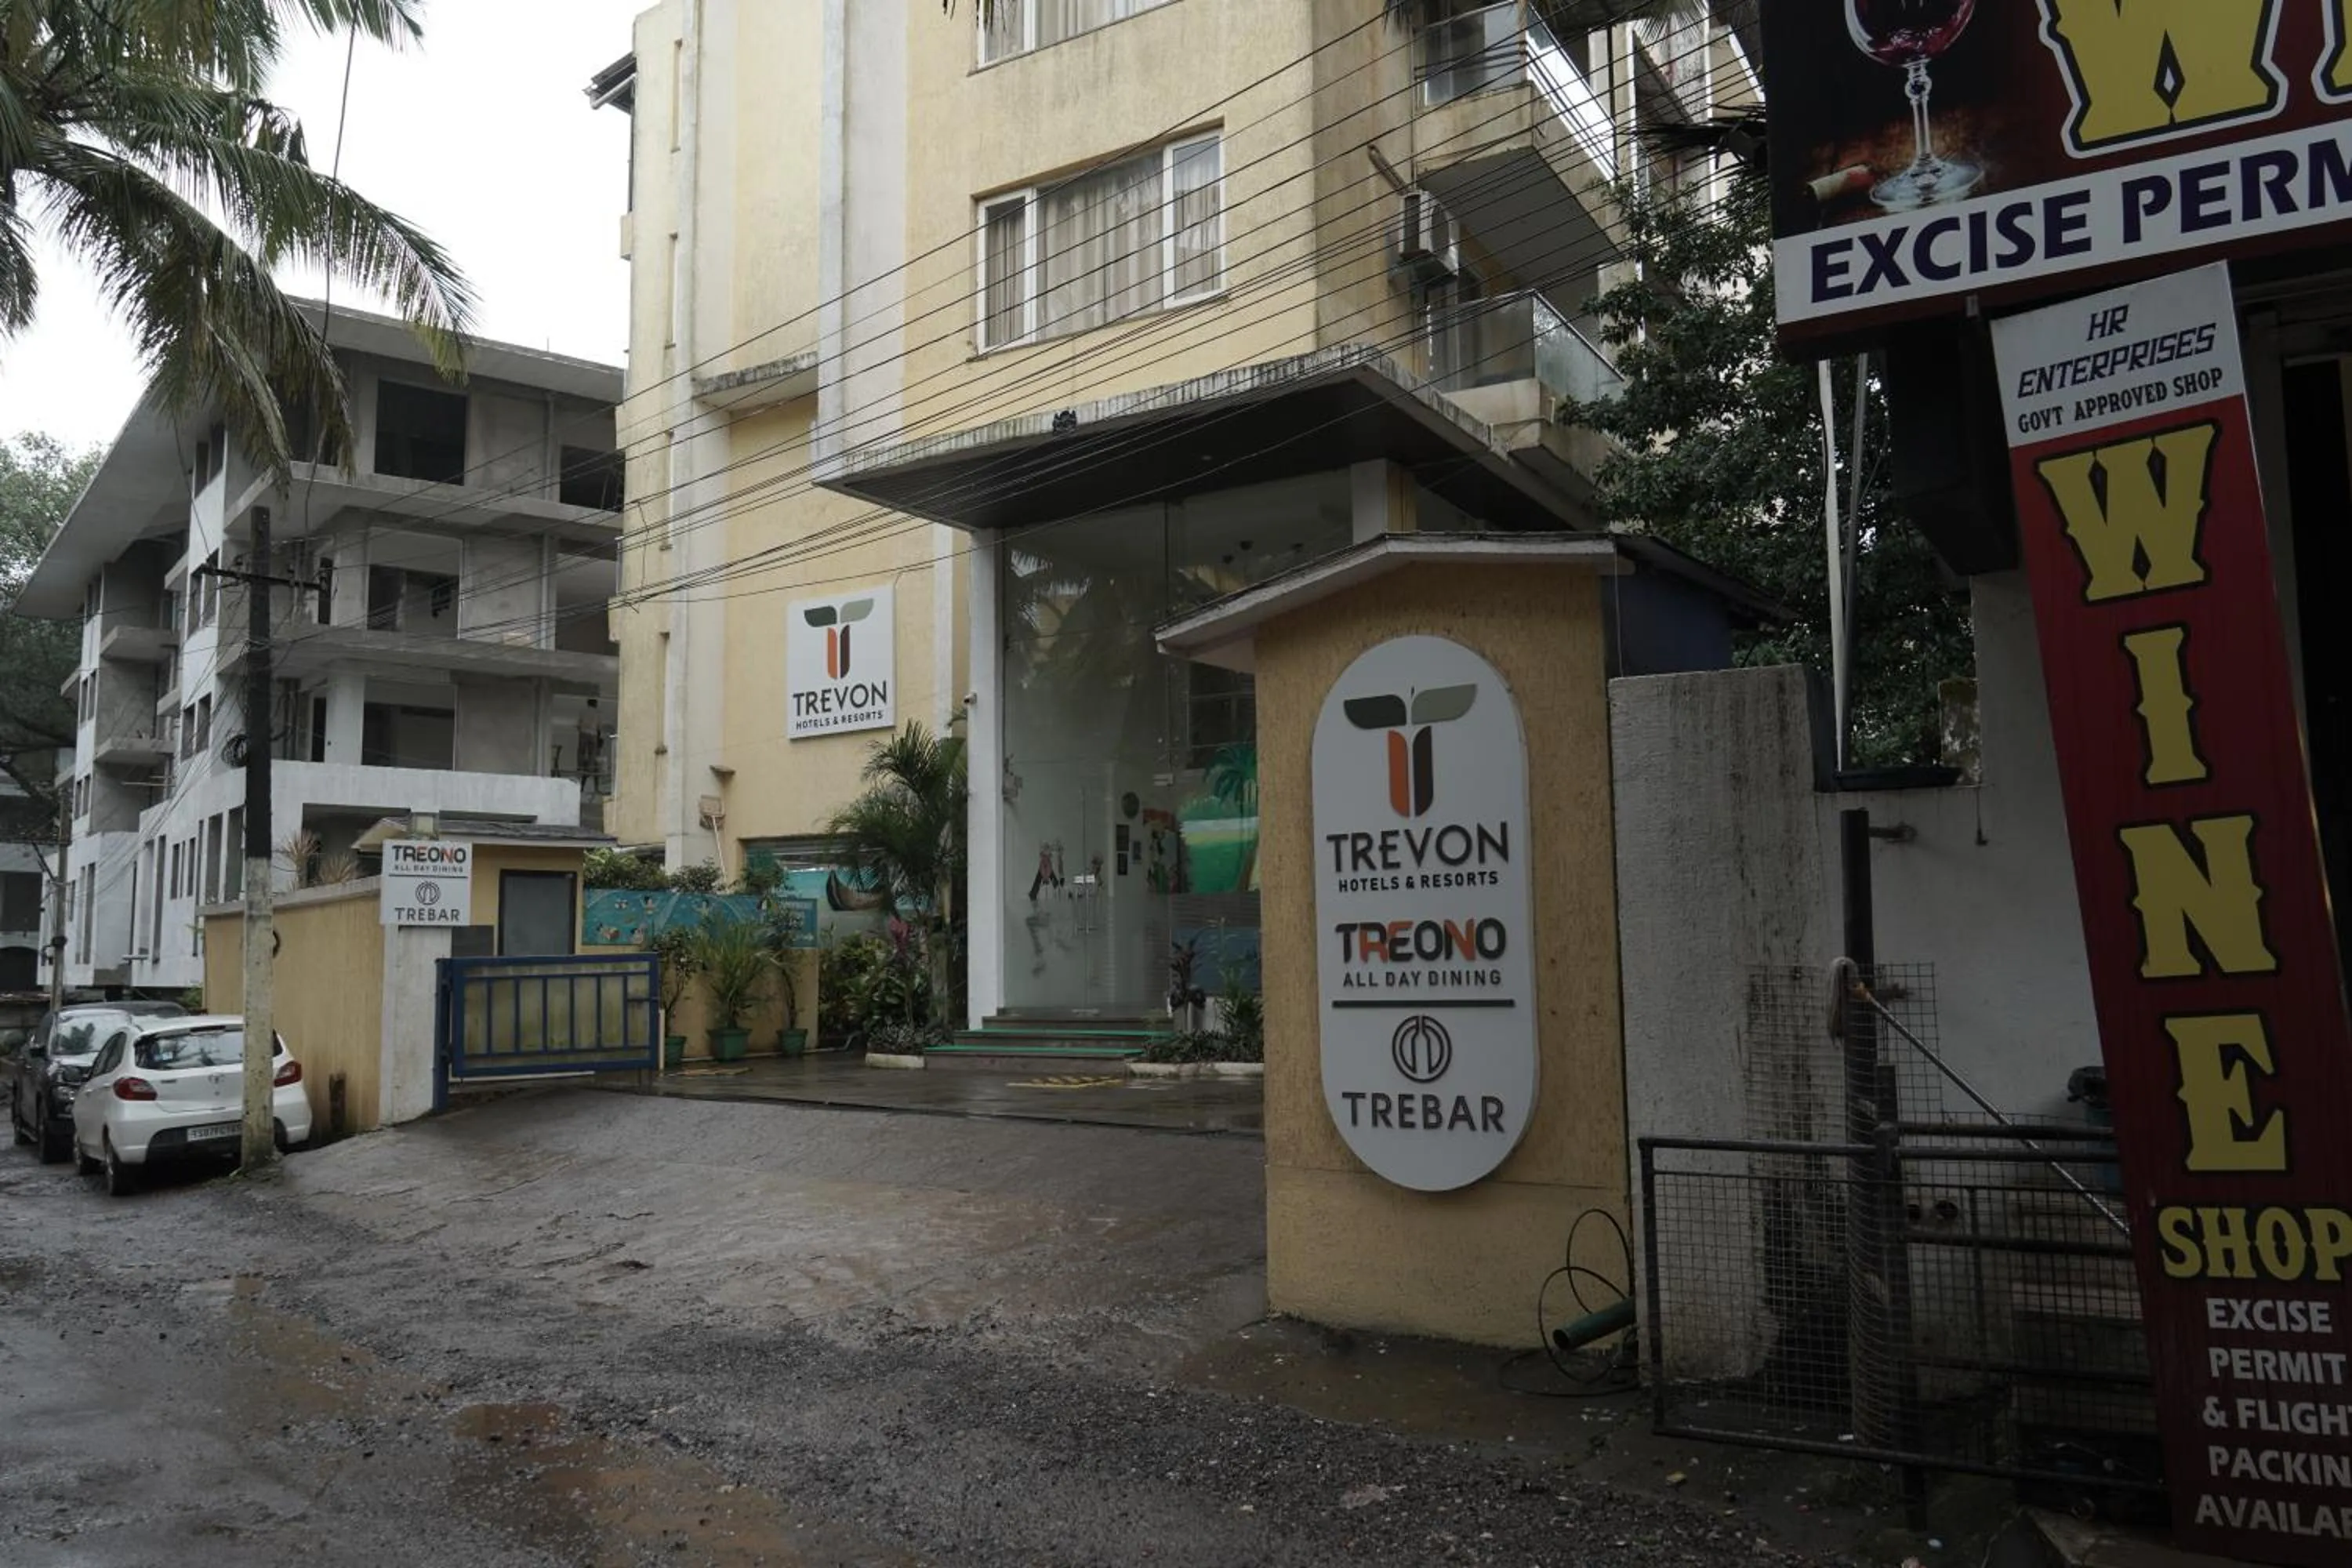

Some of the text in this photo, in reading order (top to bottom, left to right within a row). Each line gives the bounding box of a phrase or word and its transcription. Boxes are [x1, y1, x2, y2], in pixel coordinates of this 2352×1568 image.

[1810, 189, 2092, 303] EXCISE
[2086, 303, 2130, 341] HR
[2017, 323, 2217, 398] ENTERPRISES
[2018, 367, 2223, 433] GOVT APPROVED SHOP
[793, 680, 887, 717] TREVON
[796, 710, 884, 730] HOTELS & RESORTS
[2035, 419, 2291, 1173] WINE
[392, 844, 466, 863] TREONO
[1326, 821, 1509, 873] TREVON
[1338, 871, 1498, 893] HOTELS & RESORTS
[394, 907, 460, 921] TREBAR
[1335, 917, 1506, 964] TREONO
[1342, 969, 1502, 988] ALL DAY DINING
[1341, 1092, 1506, 1133] TREBAR
[2158, 1206, 2352, 1282] SHOP
[2205, 1298, 2333, 1334] EXCISE
[2208, 1347, 2347, 1385] PERMIT
[2201, 1396, 2352, 1436] & FLIGH
